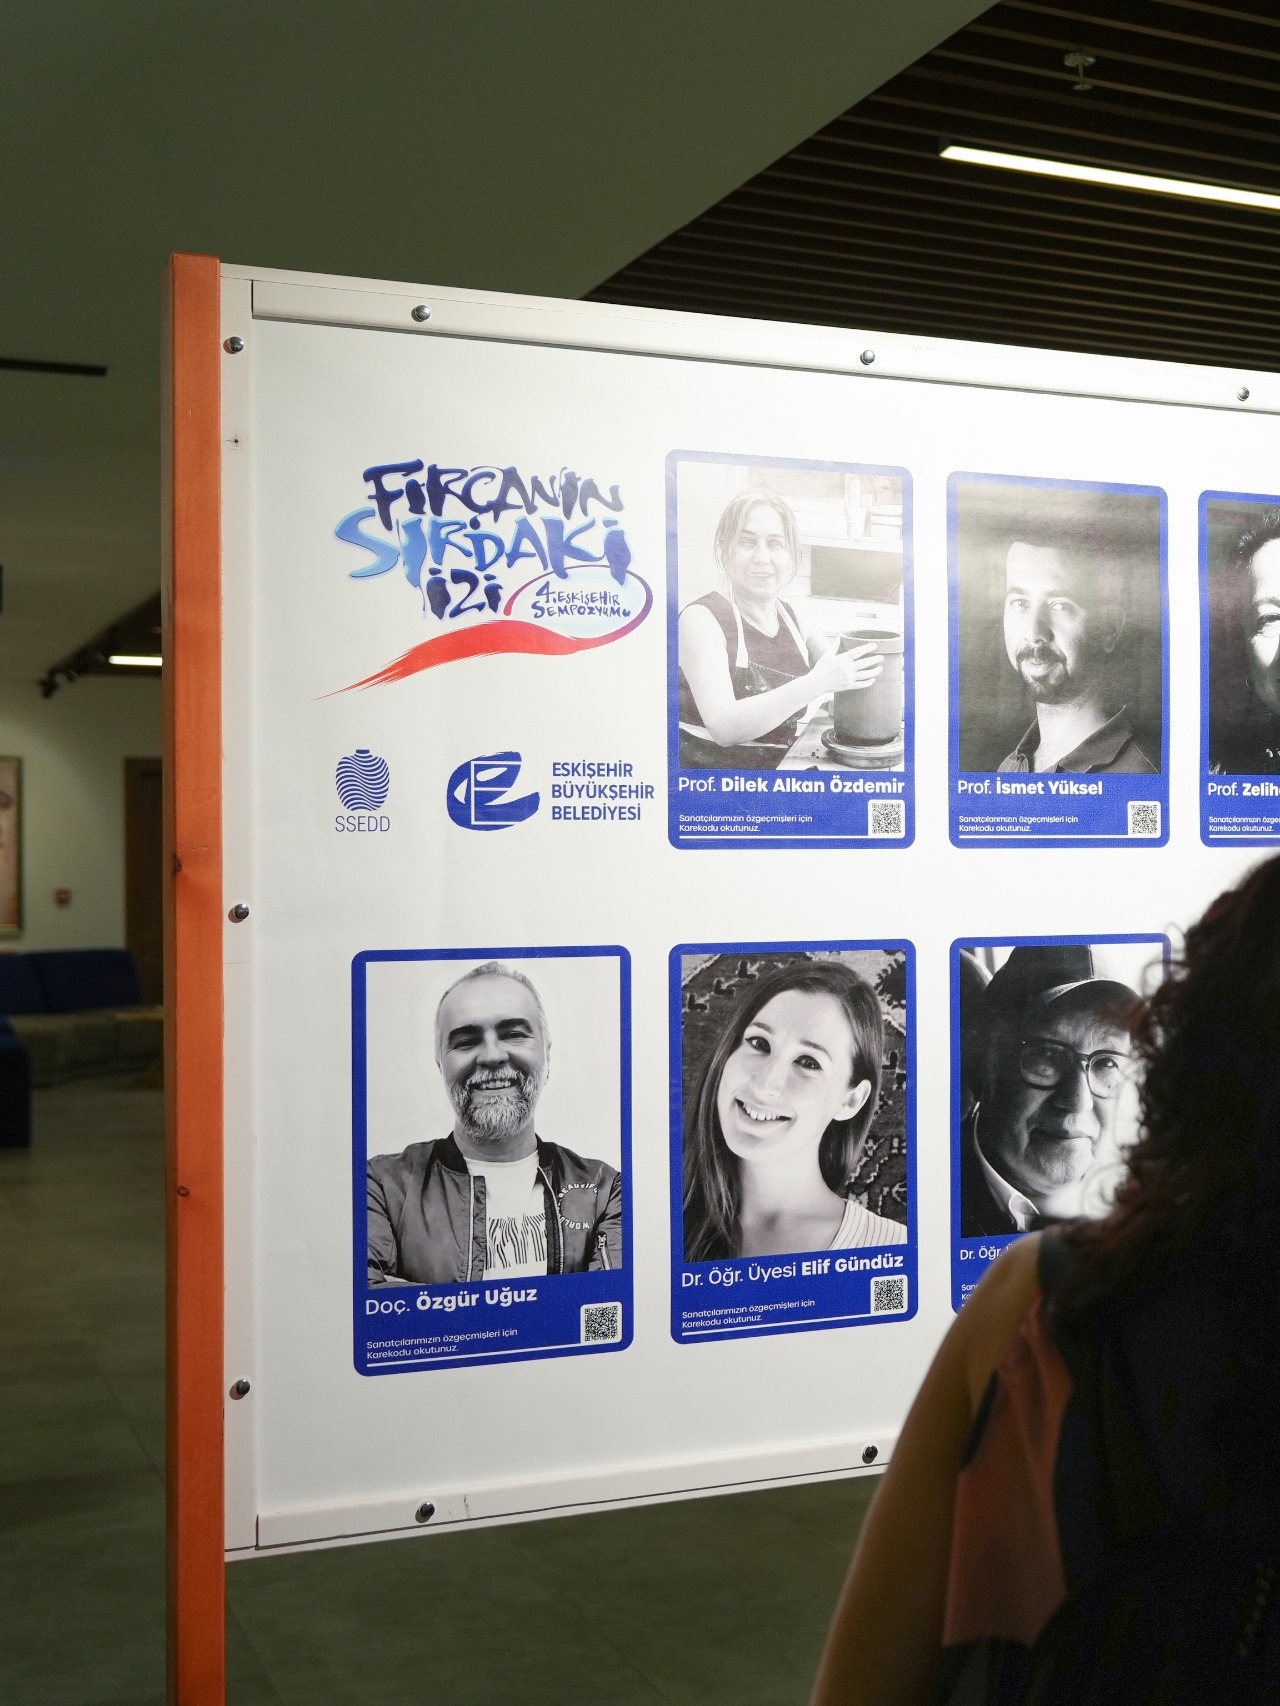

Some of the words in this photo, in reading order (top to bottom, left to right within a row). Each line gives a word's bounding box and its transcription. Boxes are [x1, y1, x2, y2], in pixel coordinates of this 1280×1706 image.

[551, 759, 634, 780] ESKİŞEHİR
[551, 780, 655, 802] BÜYÜKŞEHİR
[678, 777, 716, 792] Prof.
[721, 776, 768, 792] Dilek
[773, 778, 825, 793] Alkan
[830, 775, 905, 793] Özdemir
[958, 780, 992, 794] Prof.
[996, 777, 1044, 795] İsmet
[1048, 780, 1103, 795] Yüksel
[1207, 782, 1239, 796] Prof.
[551, 803, 642, 821] BELEDİYESİ
[679, 814, 744, 823] Sanatçılarımızın
[745, 815, 797, 824] özgeçmişleri
[798, 814, 813, 823] için
[959, 815, 1018, 824] Sanatçılarımızın
[1019, 815, 1064, 824] özgeçmişleri
[1065, 815, 1079, 823] için
[334, 815, 391, 833] SSEDD
[679, 824, 718, 832] Karekodu
[960, 1249, 976, 1260] Dr.
[681, 1272, 704, 1287] Dr.
[709, 1266, 744, 1287] Öğr.
[748, 1261, 797, 1283] Üyesi
[801, 1258, 831, 1276] Elif
[835, 1252, 904, 1273] Gündüz
[365, 1299, 411, 1315] Doç.
[416, 1290, 480, 1312] Özgür
[485, 1286, 538, 1307] Uğuz
[682, 1306, 748, 1319] Sanatçılarımızın
[748, 1300, 800, 1313] özgeçmişleri
[801, 1298, 816, 1309] için
[682, 1318, 722, 1328] Karekodu
[723, 1314, 763, 1325] okutunuz.
[366, 1335, 441, 1349] Sanatçılarımızın
[442, 1330, 501, 1342] özgeçmişleri
[501, 1328, 519, 1338] için
[366, 1349, 412, 1359] Karekodu
[413, 1345, 459, 1355] okutunuz.
